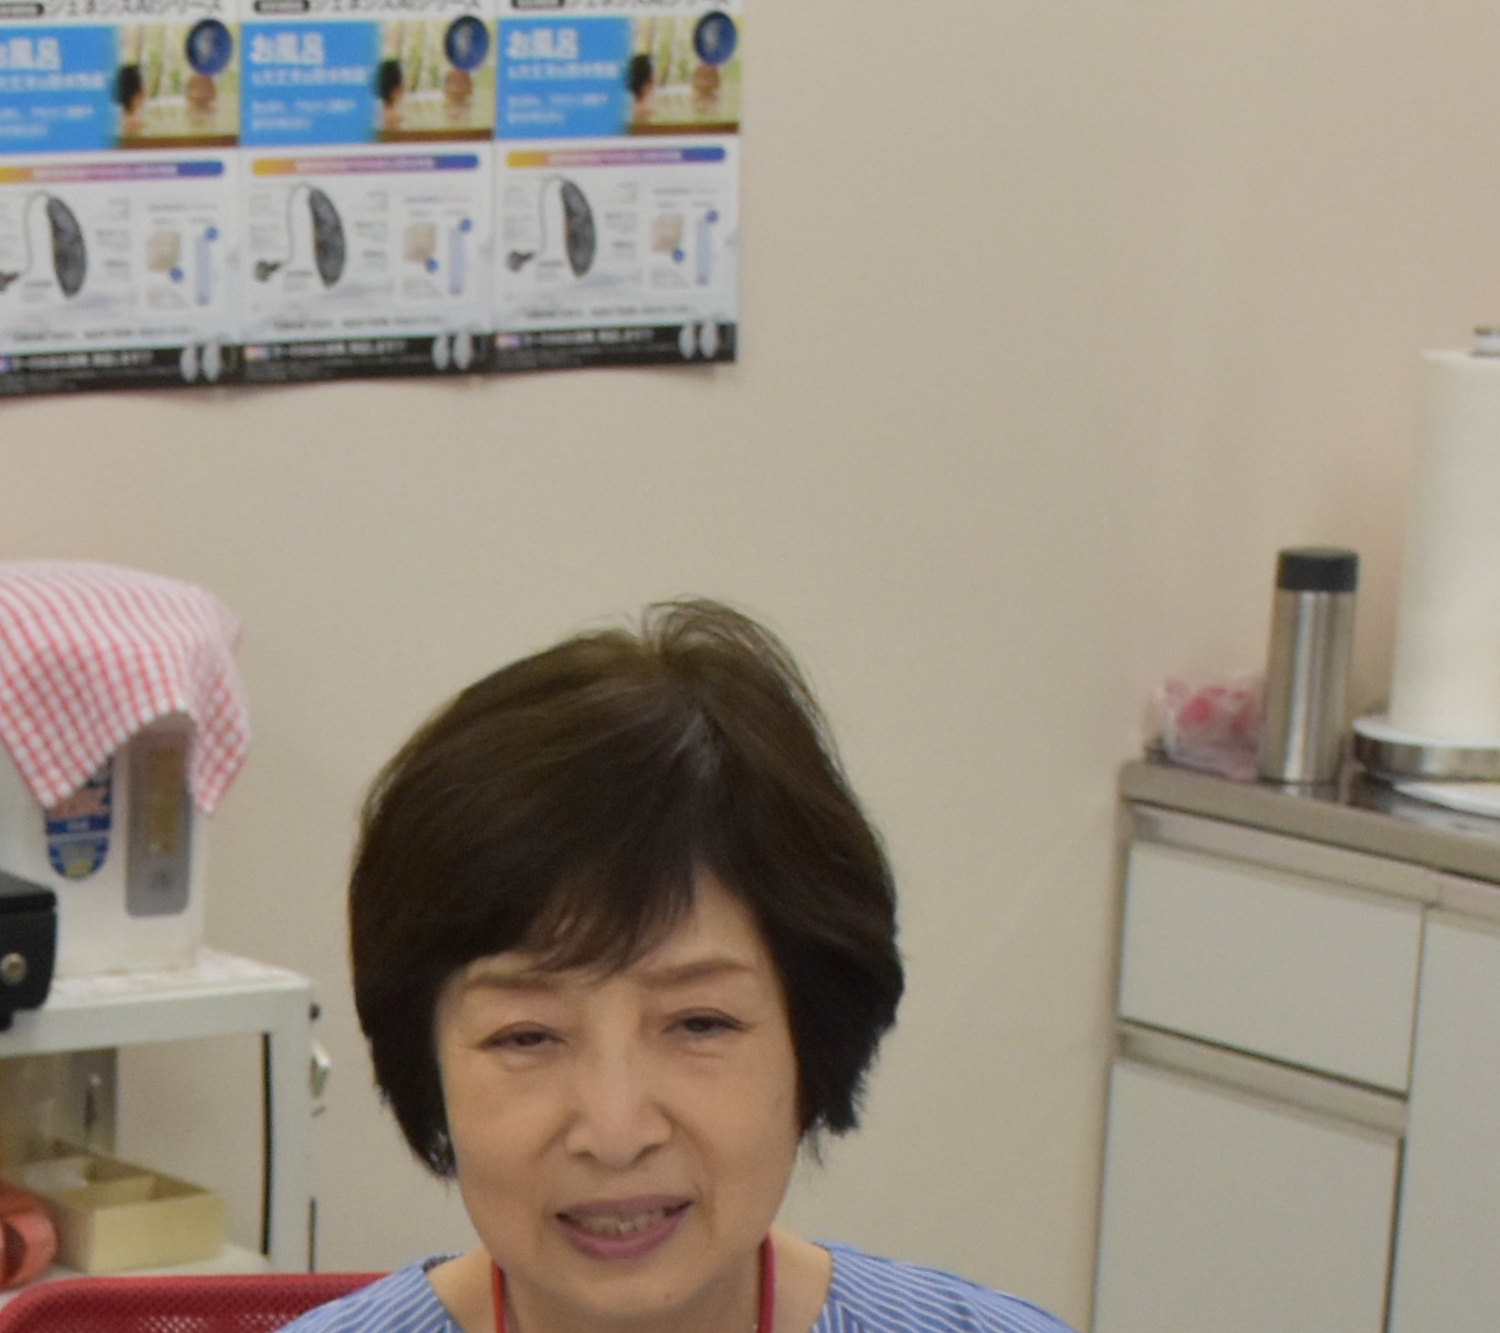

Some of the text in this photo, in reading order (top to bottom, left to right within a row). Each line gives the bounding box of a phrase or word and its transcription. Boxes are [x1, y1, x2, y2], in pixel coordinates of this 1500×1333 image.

[251, 34, 326, 65] お風呂
[506, 29, 579, 60] お風呂
